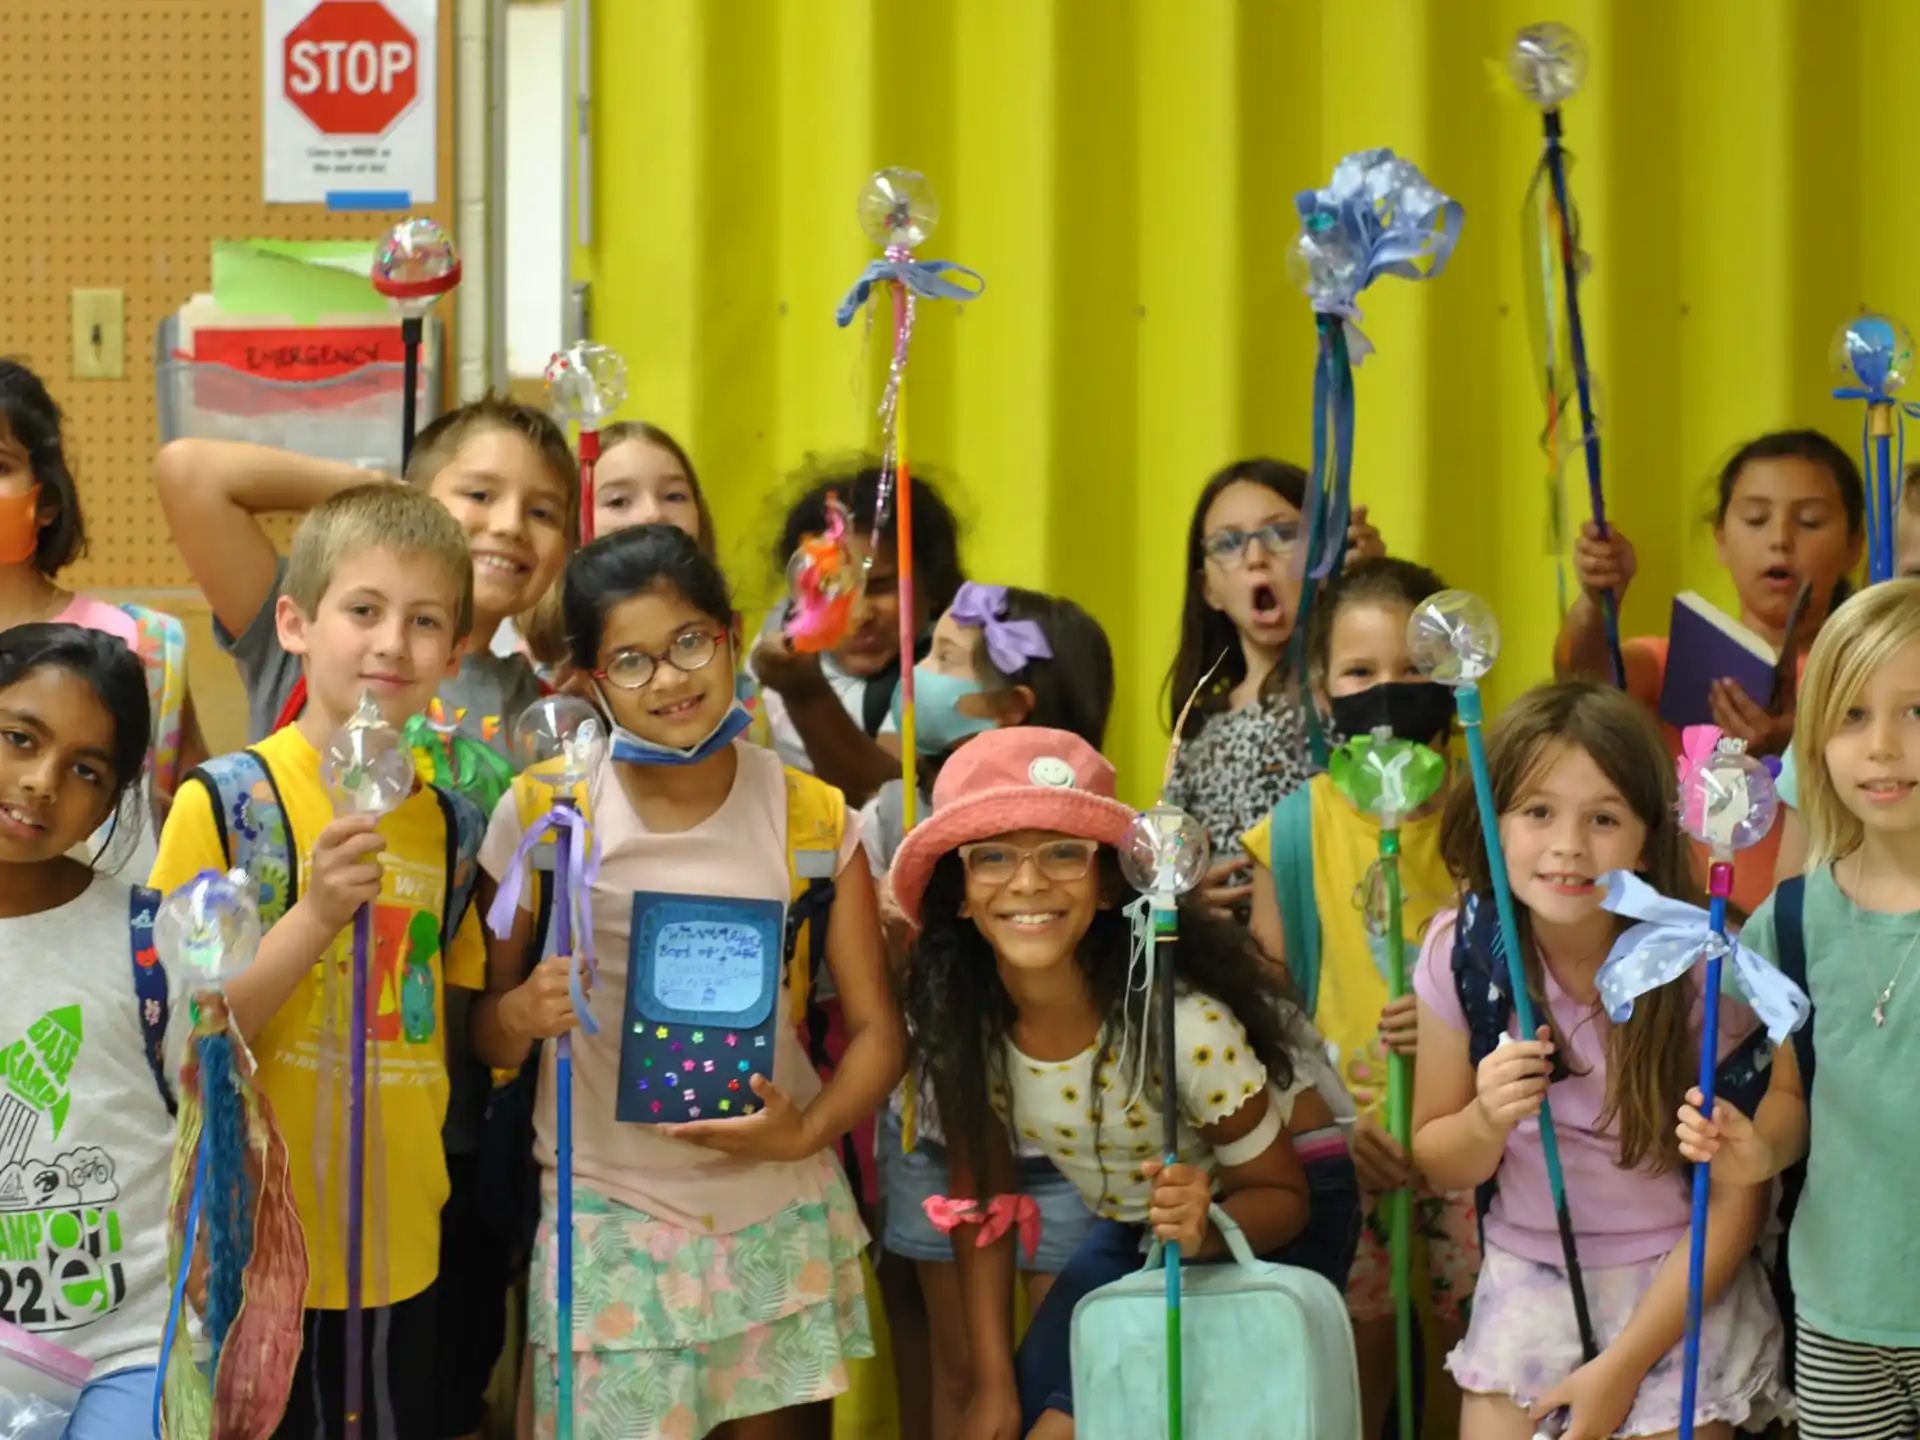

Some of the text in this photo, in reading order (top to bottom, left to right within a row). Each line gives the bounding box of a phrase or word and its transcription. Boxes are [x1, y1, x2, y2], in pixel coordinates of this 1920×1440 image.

[289, 40, 412, 95] STOP
[245, 342, 380, 369] EMERGENCY
[7, 1039, 59, 1106] CAMP
[27, 1016, 81, 1086] BASE
